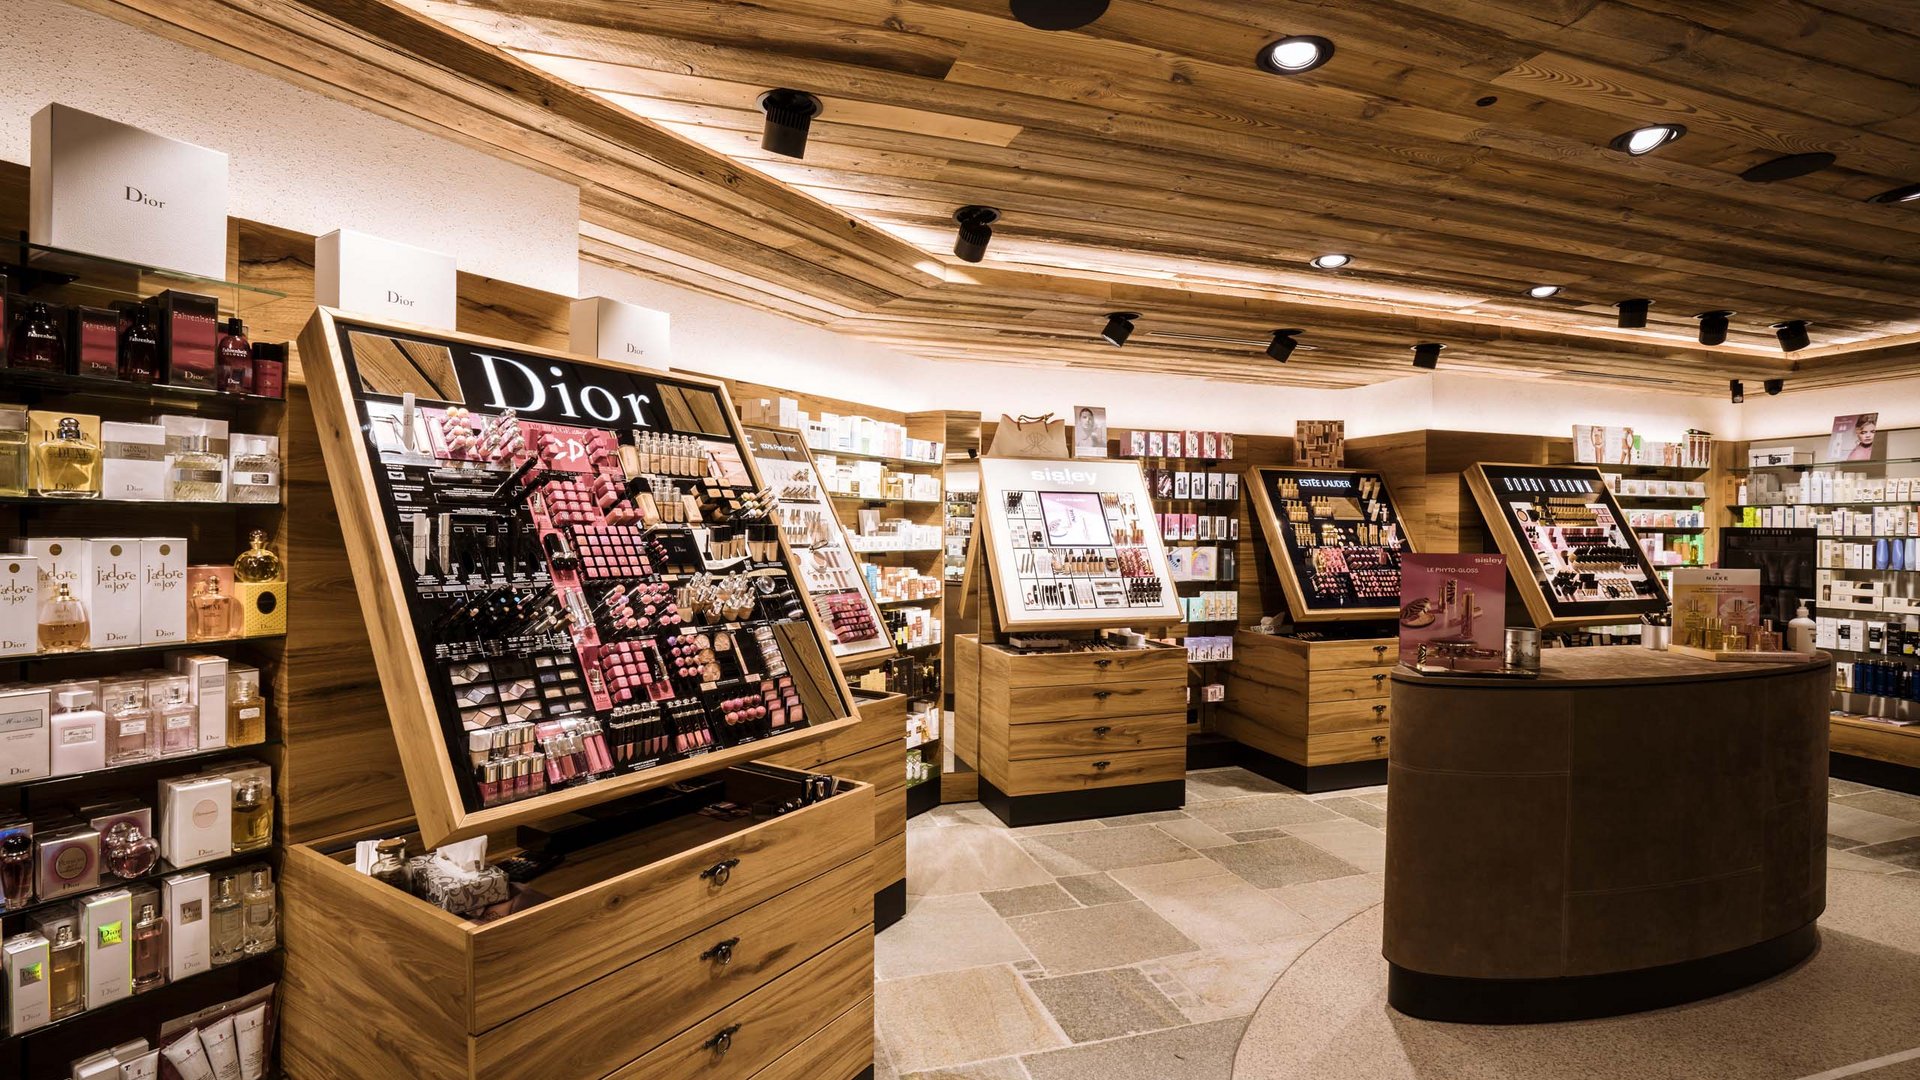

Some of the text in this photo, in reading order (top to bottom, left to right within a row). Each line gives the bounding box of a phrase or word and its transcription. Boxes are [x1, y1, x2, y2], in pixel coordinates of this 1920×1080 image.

[125, 185, 166, 209] Dior
[387, 290, 415, 307] Dior
[172, 310, 216, 325] Fahrenheit
[82, 320, 117, 332] Fahrenheit
[27, 331, 57, 341] Fahrenheit
[128, 336, 156, 345] Fahrenheit
[626, 342, 644, 356] Dior
[91, 362, 108, 370] Dior
[184, 370, 205, 381] Dior
[470, 351, 652, 427] Dior
[1031, 467, 1097, 485] sisley
[1322, 479, 1352, 488] LAUDER
[1504, 477, 1593, 493] BOBBI BROWN
[1475, 557, 1503, 565] sisley
[97, 563, 137, 585] j'adore
[146, 562, 184, 585] j'adore
[113, 580, 130, 594] joy
[162, 578, 178, 592] joy
[11, 593, 27, 606] joy
[106, 632, 128, 641] Dior
[155, 629, 176, 637] Dior
[2, 640, 28, 649] Dior
[10, 768, 31, 776] Dior
[101, 929, 121, 938] Dior
